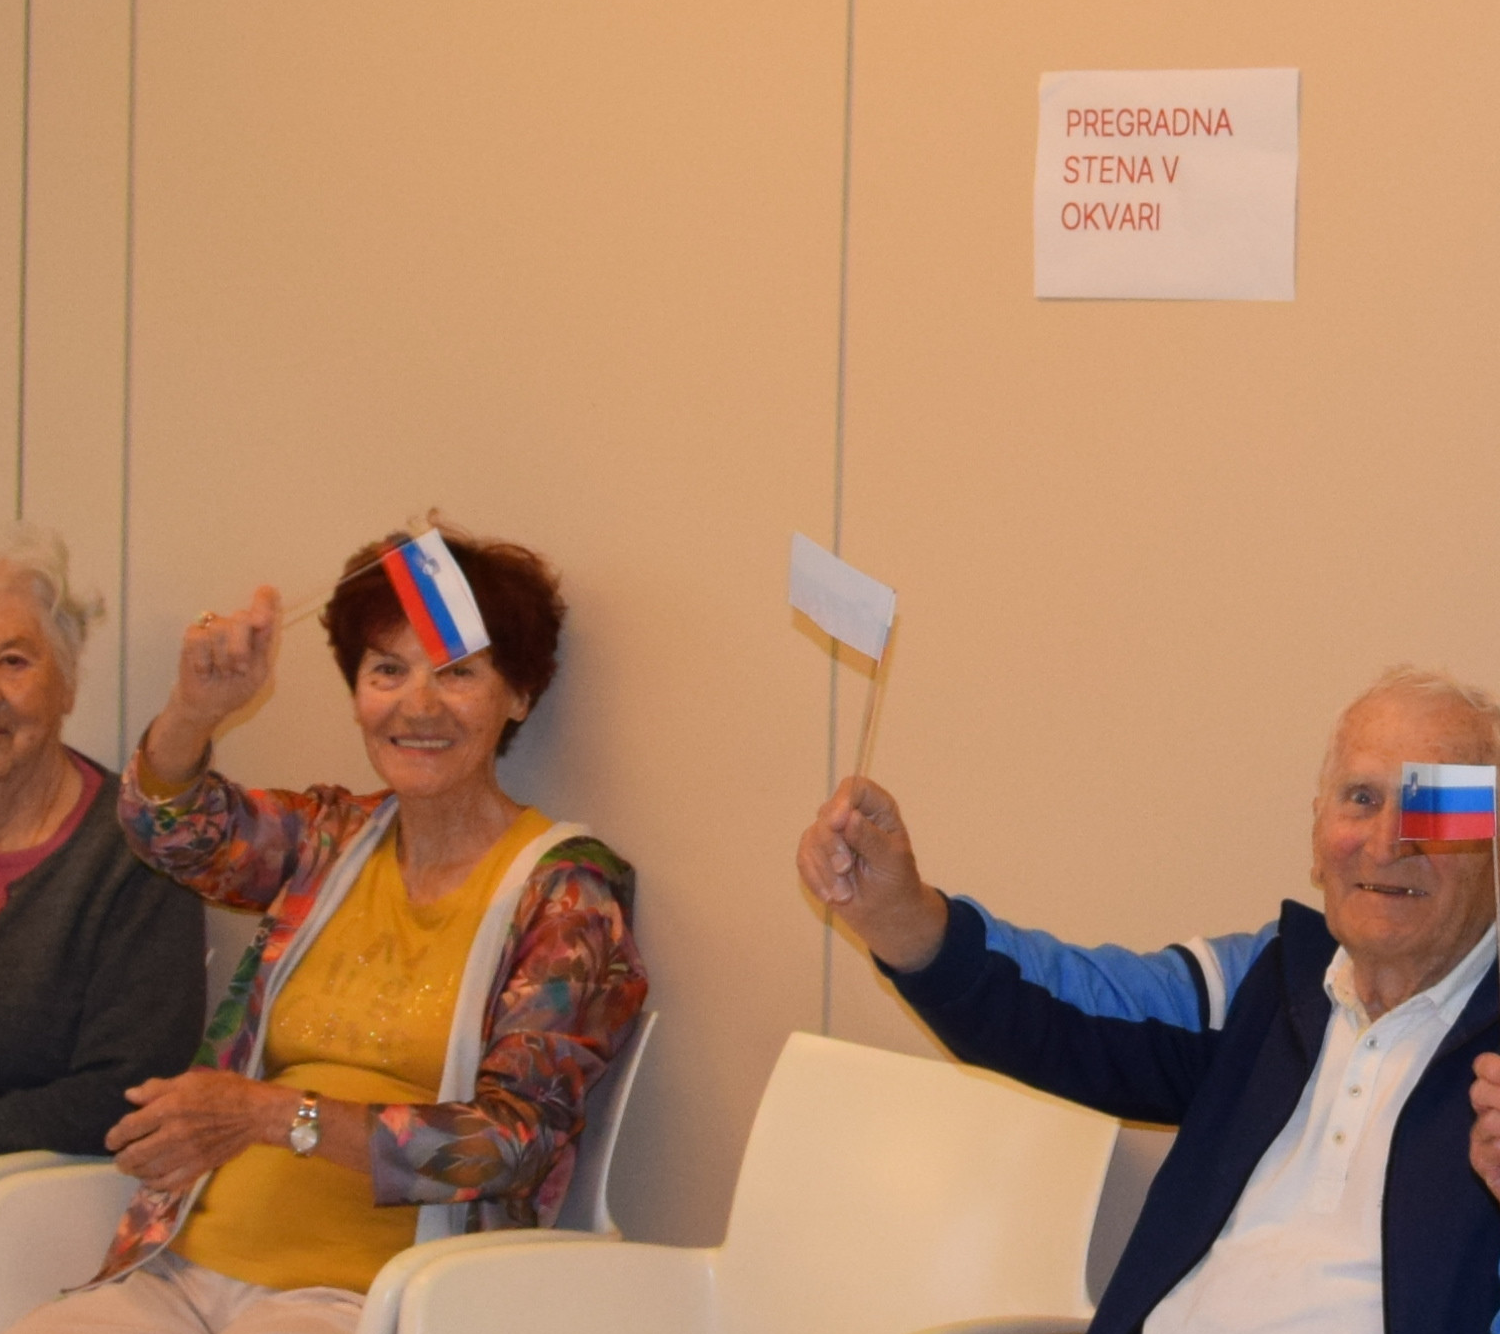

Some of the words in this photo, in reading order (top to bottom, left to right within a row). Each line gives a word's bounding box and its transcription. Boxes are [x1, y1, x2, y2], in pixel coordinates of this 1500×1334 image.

[1065, 107, 1233, 138] PREGRADNA
[1062, 155, 1154, 184] STENA
[1162, 155, 1180, 184] V
[1060, 202, 1161, 232] OKVARI
